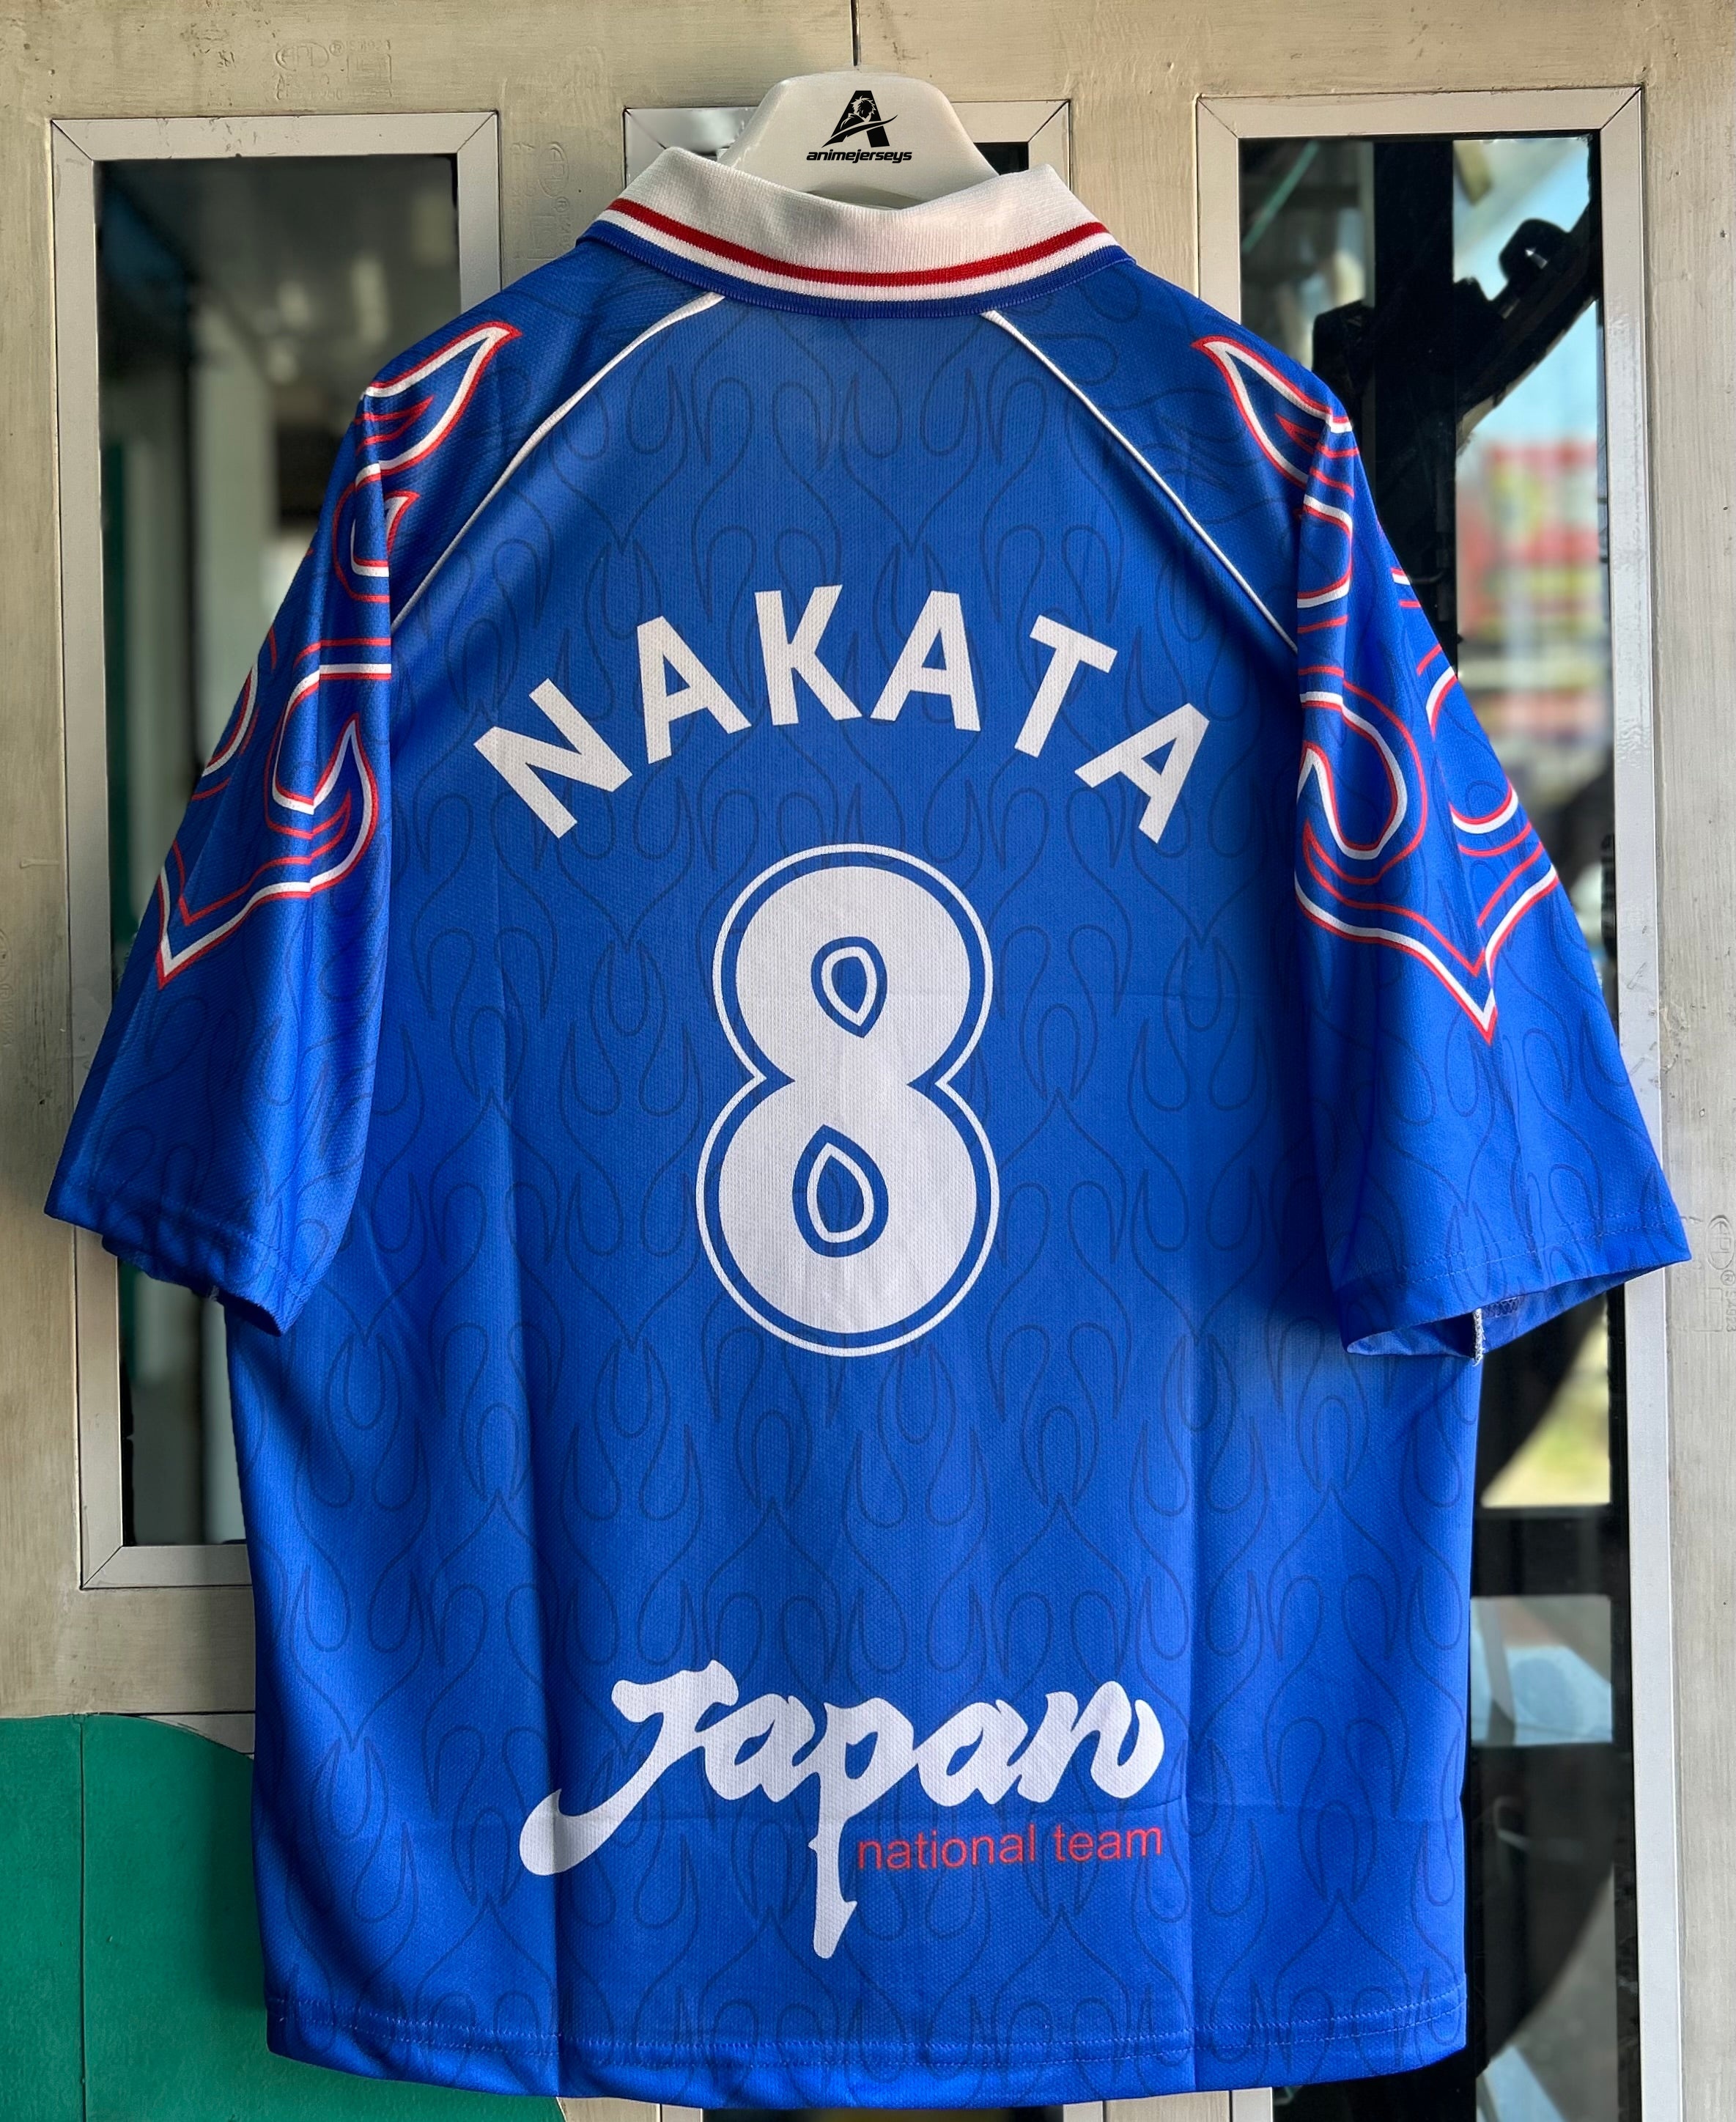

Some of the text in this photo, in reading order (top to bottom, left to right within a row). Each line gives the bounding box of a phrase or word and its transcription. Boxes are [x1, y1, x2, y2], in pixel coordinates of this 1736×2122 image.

[806, 149, 913, 164] animejerseys
[473, 584, 1210, 844] NAKATA
[695, 843, 1000, 1357] 8
[858, 1824, 1163, 1871] national team
